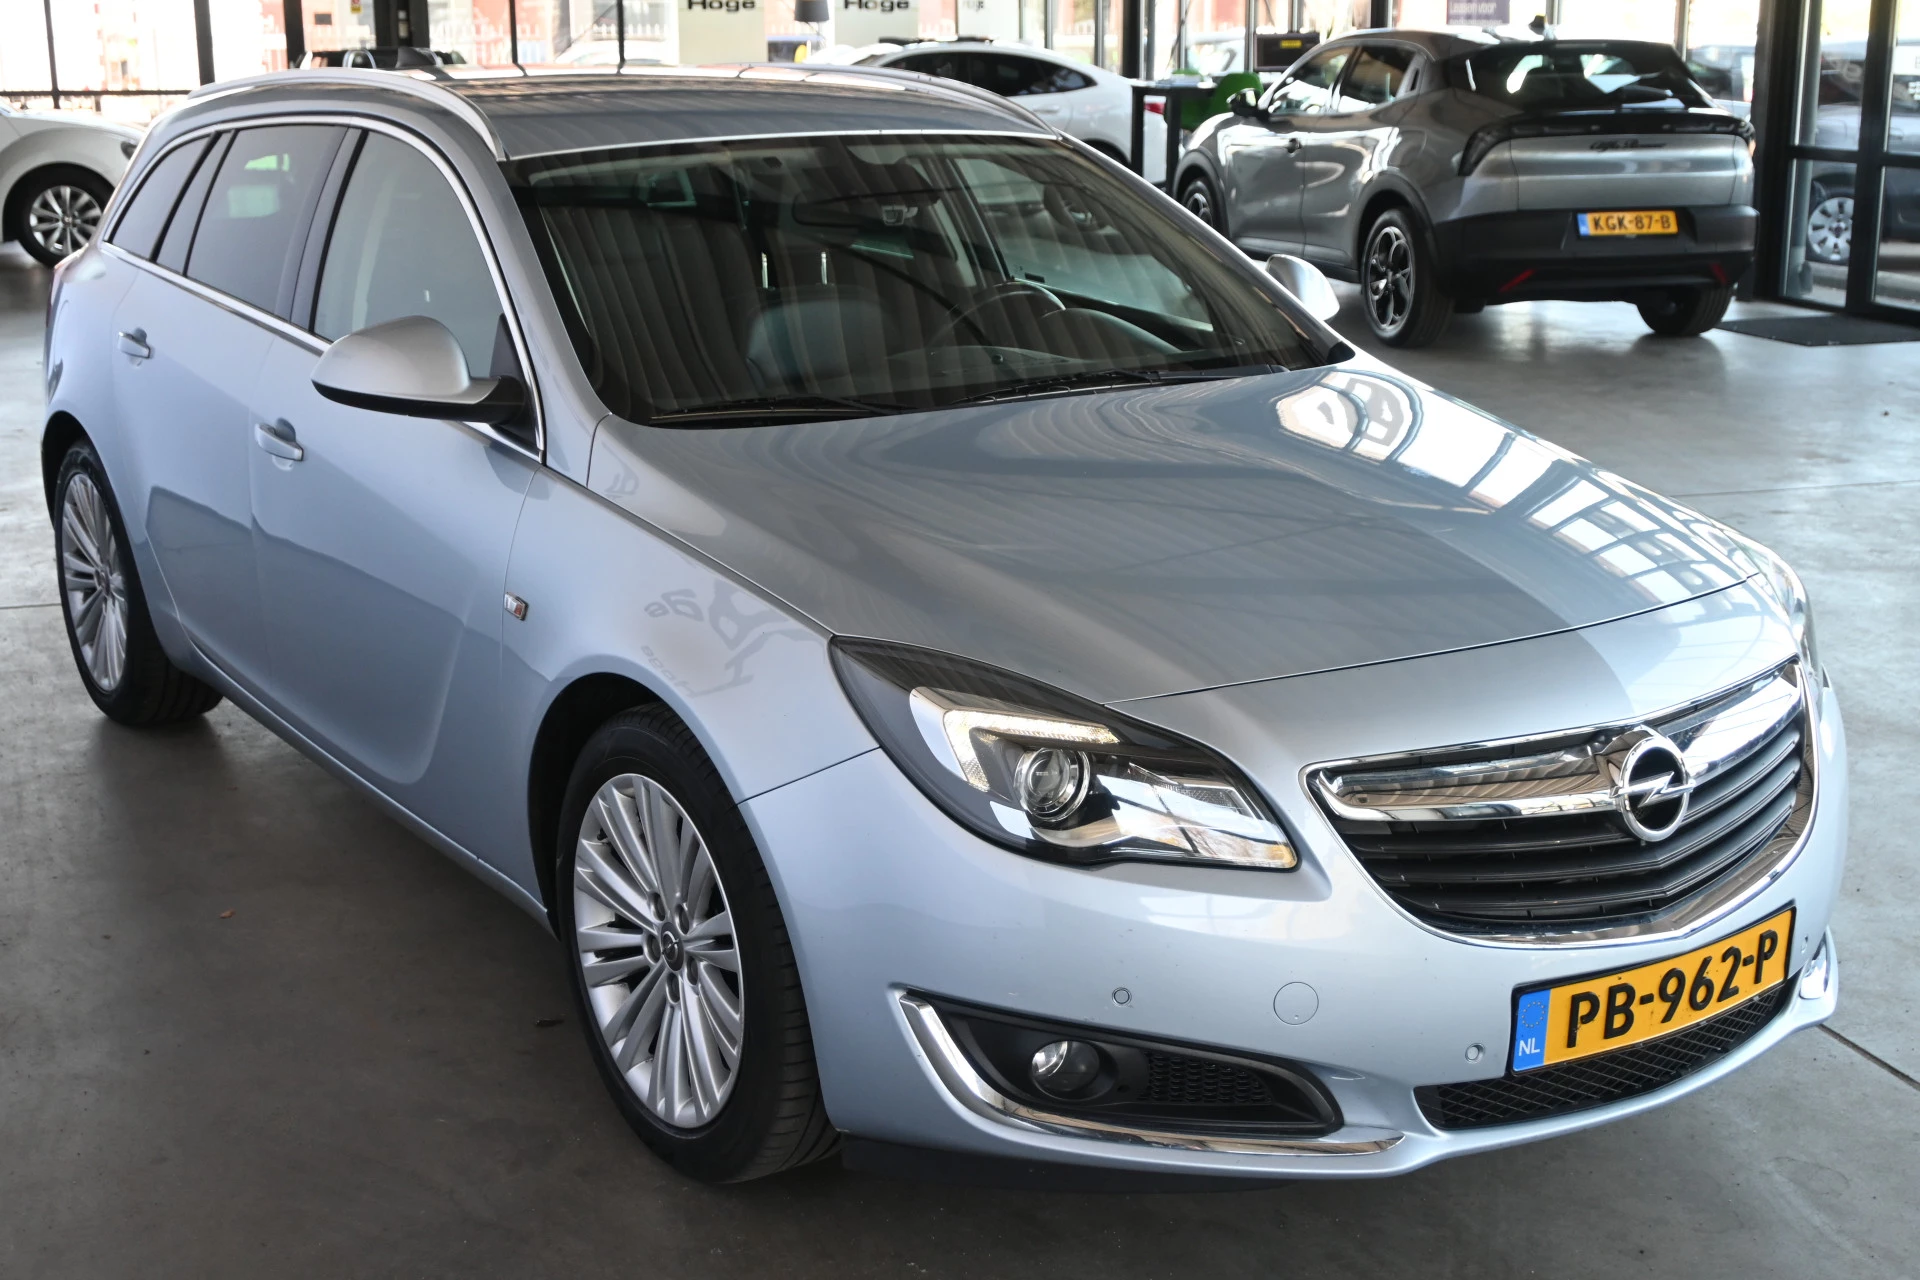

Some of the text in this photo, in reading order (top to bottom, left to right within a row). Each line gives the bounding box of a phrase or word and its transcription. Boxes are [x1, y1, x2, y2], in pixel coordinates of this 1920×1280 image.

[688, 0, 755, 12] Hoge
[844, 0, 909, 12] Hoge
[1592, 214, 1672, 231] KGK-87-B
[1566, 929, 1779, 1049] PB-962-P
[1518, 1038, 1541, 1056] NL
